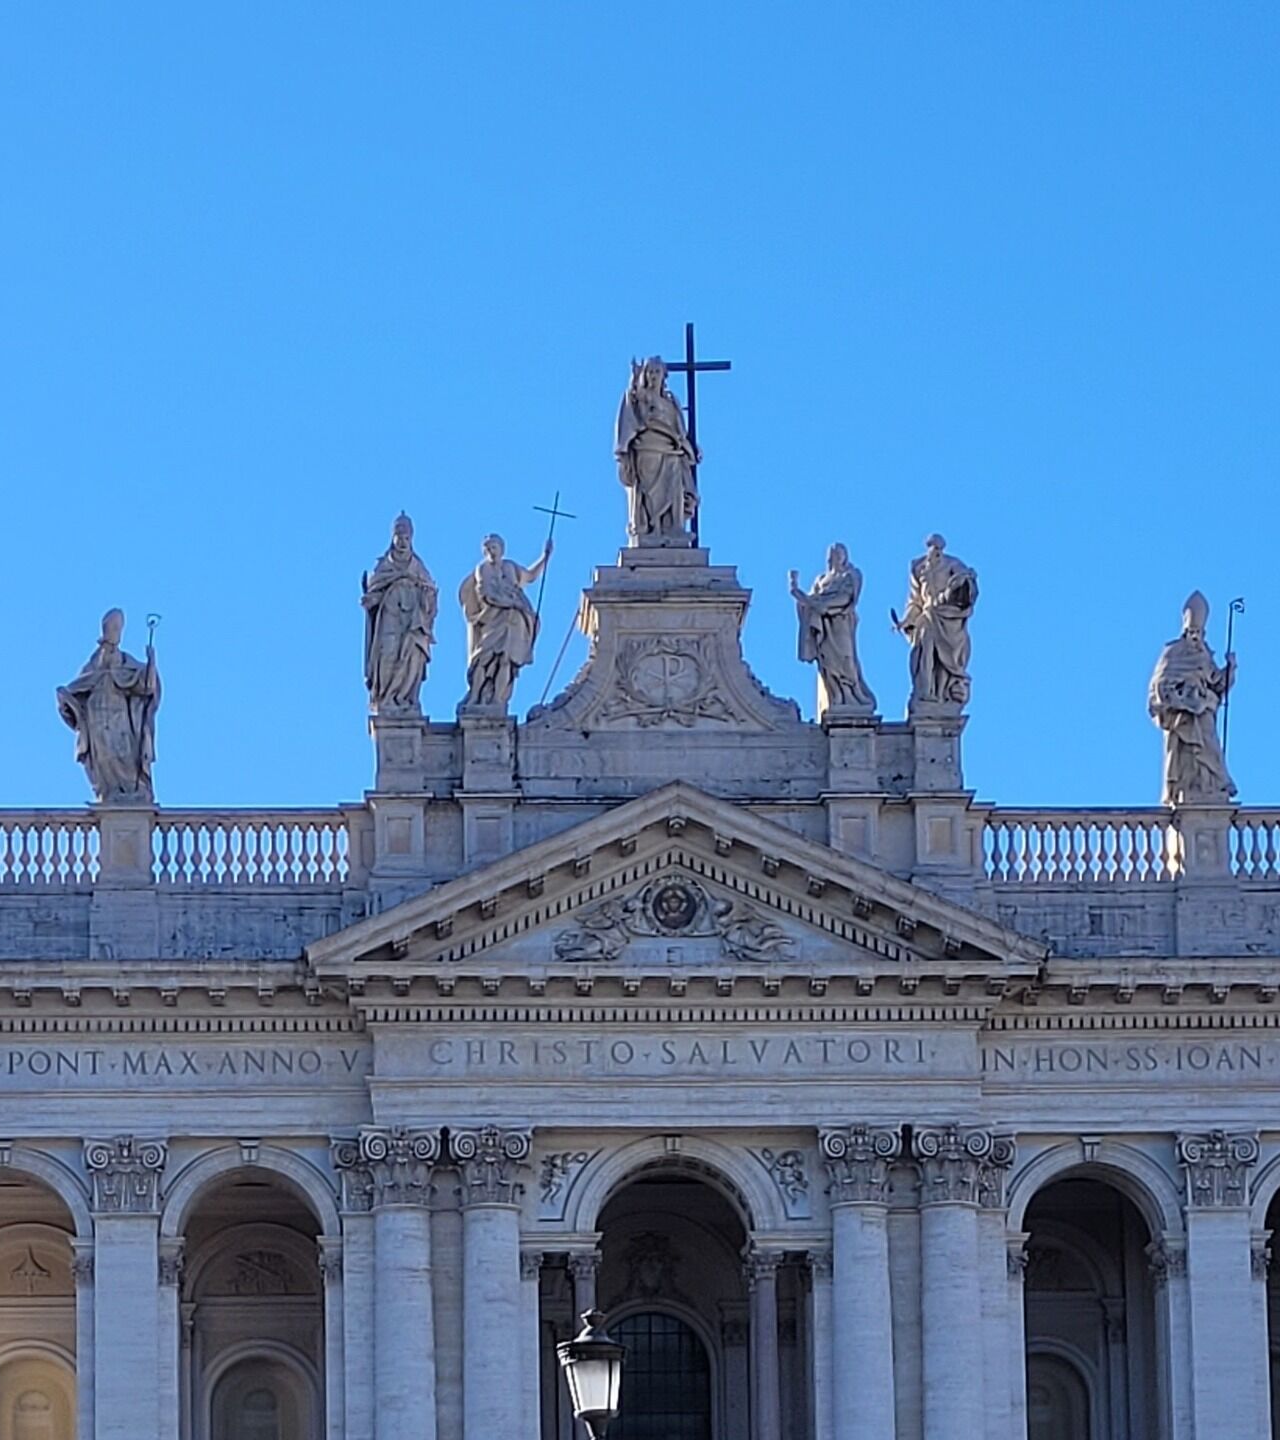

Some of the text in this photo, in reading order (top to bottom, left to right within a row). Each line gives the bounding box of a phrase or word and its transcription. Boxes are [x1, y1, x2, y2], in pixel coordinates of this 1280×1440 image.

[7, 1050, 105, 1076] PONT
[122, 1049, 201, 1076] MAX
[218, 1049, 322, 1075] ANNO
[338, 1049, 360, 1073] V
[427, 1039, 927, 1066] CHRISTO SALVATORI
[979, 1047, 1016, 1072] IN
[1034, 1047, 1109, 1072] HON
[1126, 1046, 1158, 1071] SS
[1175, 1045, 1262, 1071] IOAN
